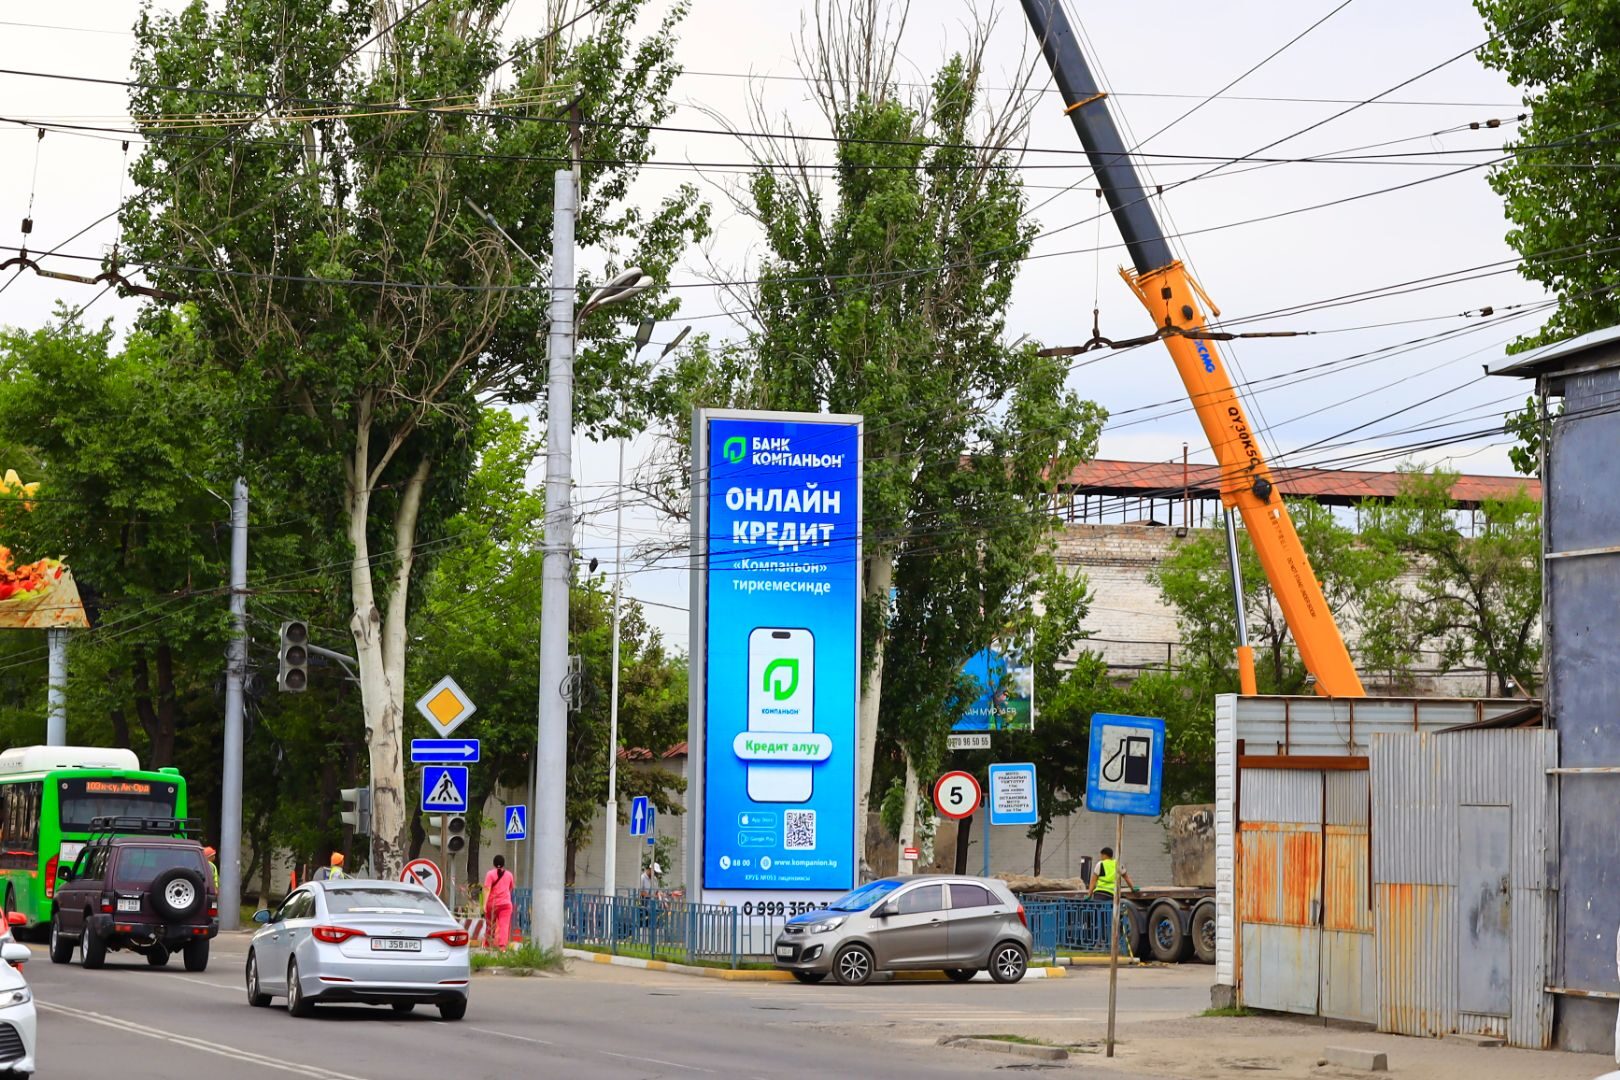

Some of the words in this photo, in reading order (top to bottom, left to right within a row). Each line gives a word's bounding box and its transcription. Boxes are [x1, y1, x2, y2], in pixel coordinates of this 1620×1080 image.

[752, 437, 790, 451] БАНК
[752, 452, 842, 468] КОМПАНЬОН
[725, 482, 841, 514] ОНЛАЙН
[732, 521, 834, 551] КРЕДИТ
[733, 559, 827, 573] «Компаньон»
[732, 579, 831, 596] тиркемесинде
[745, 740, 788, 754] Кредит
[792, 744, 820, 755] алуу
[950, 787, 963, 805] 5
[774, 858, 838, 868] www.kompanion.kg
[743, 901, 753, 916] 0
[757, 901, 785, 917] 999
